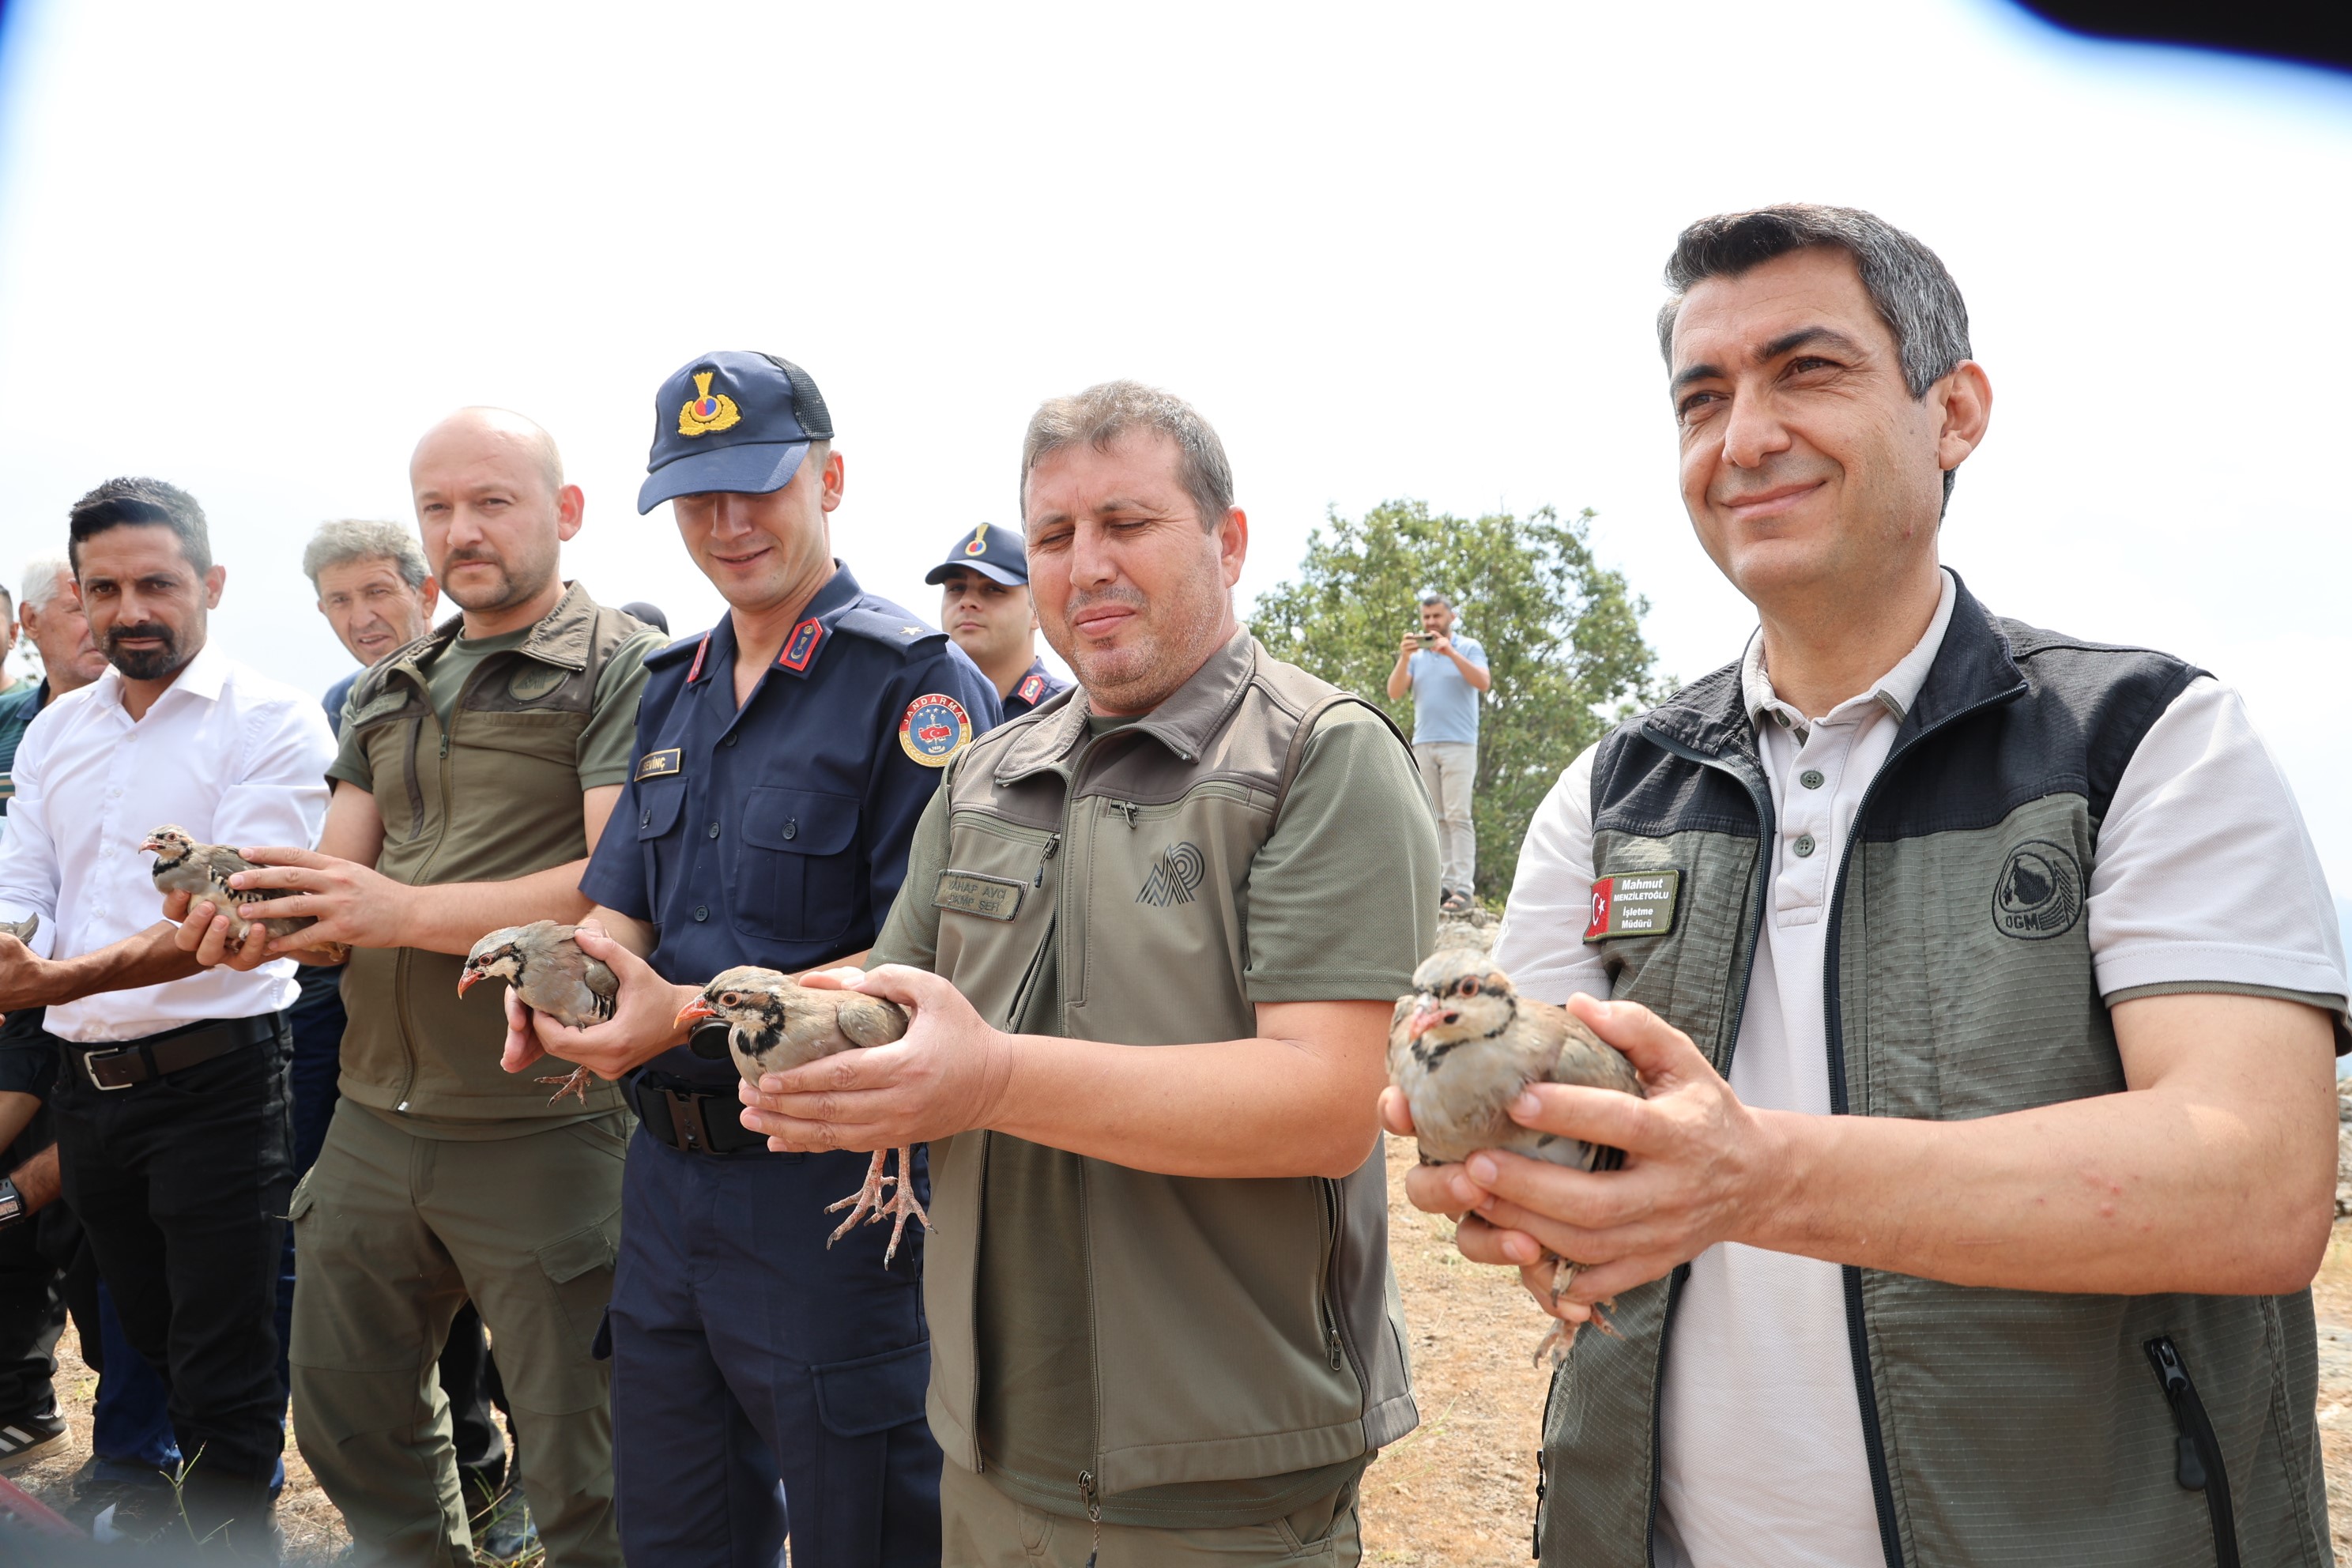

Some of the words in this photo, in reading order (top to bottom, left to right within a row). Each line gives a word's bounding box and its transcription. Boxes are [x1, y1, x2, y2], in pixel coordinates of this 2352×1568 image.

[903, 696, 963, 725] JANDARMA
[643, 756, 665, 771] SEVİNÇ
[1622, 878, 1664, 891] Mahmut
[1613, 891, 1669, 903] MENZİLETOĞLU
[1623, 906, 1654, 918] İşletme
[1621, 918, 1653, 929] Müdürü
[2005, 912, 2041, 931] OGM
